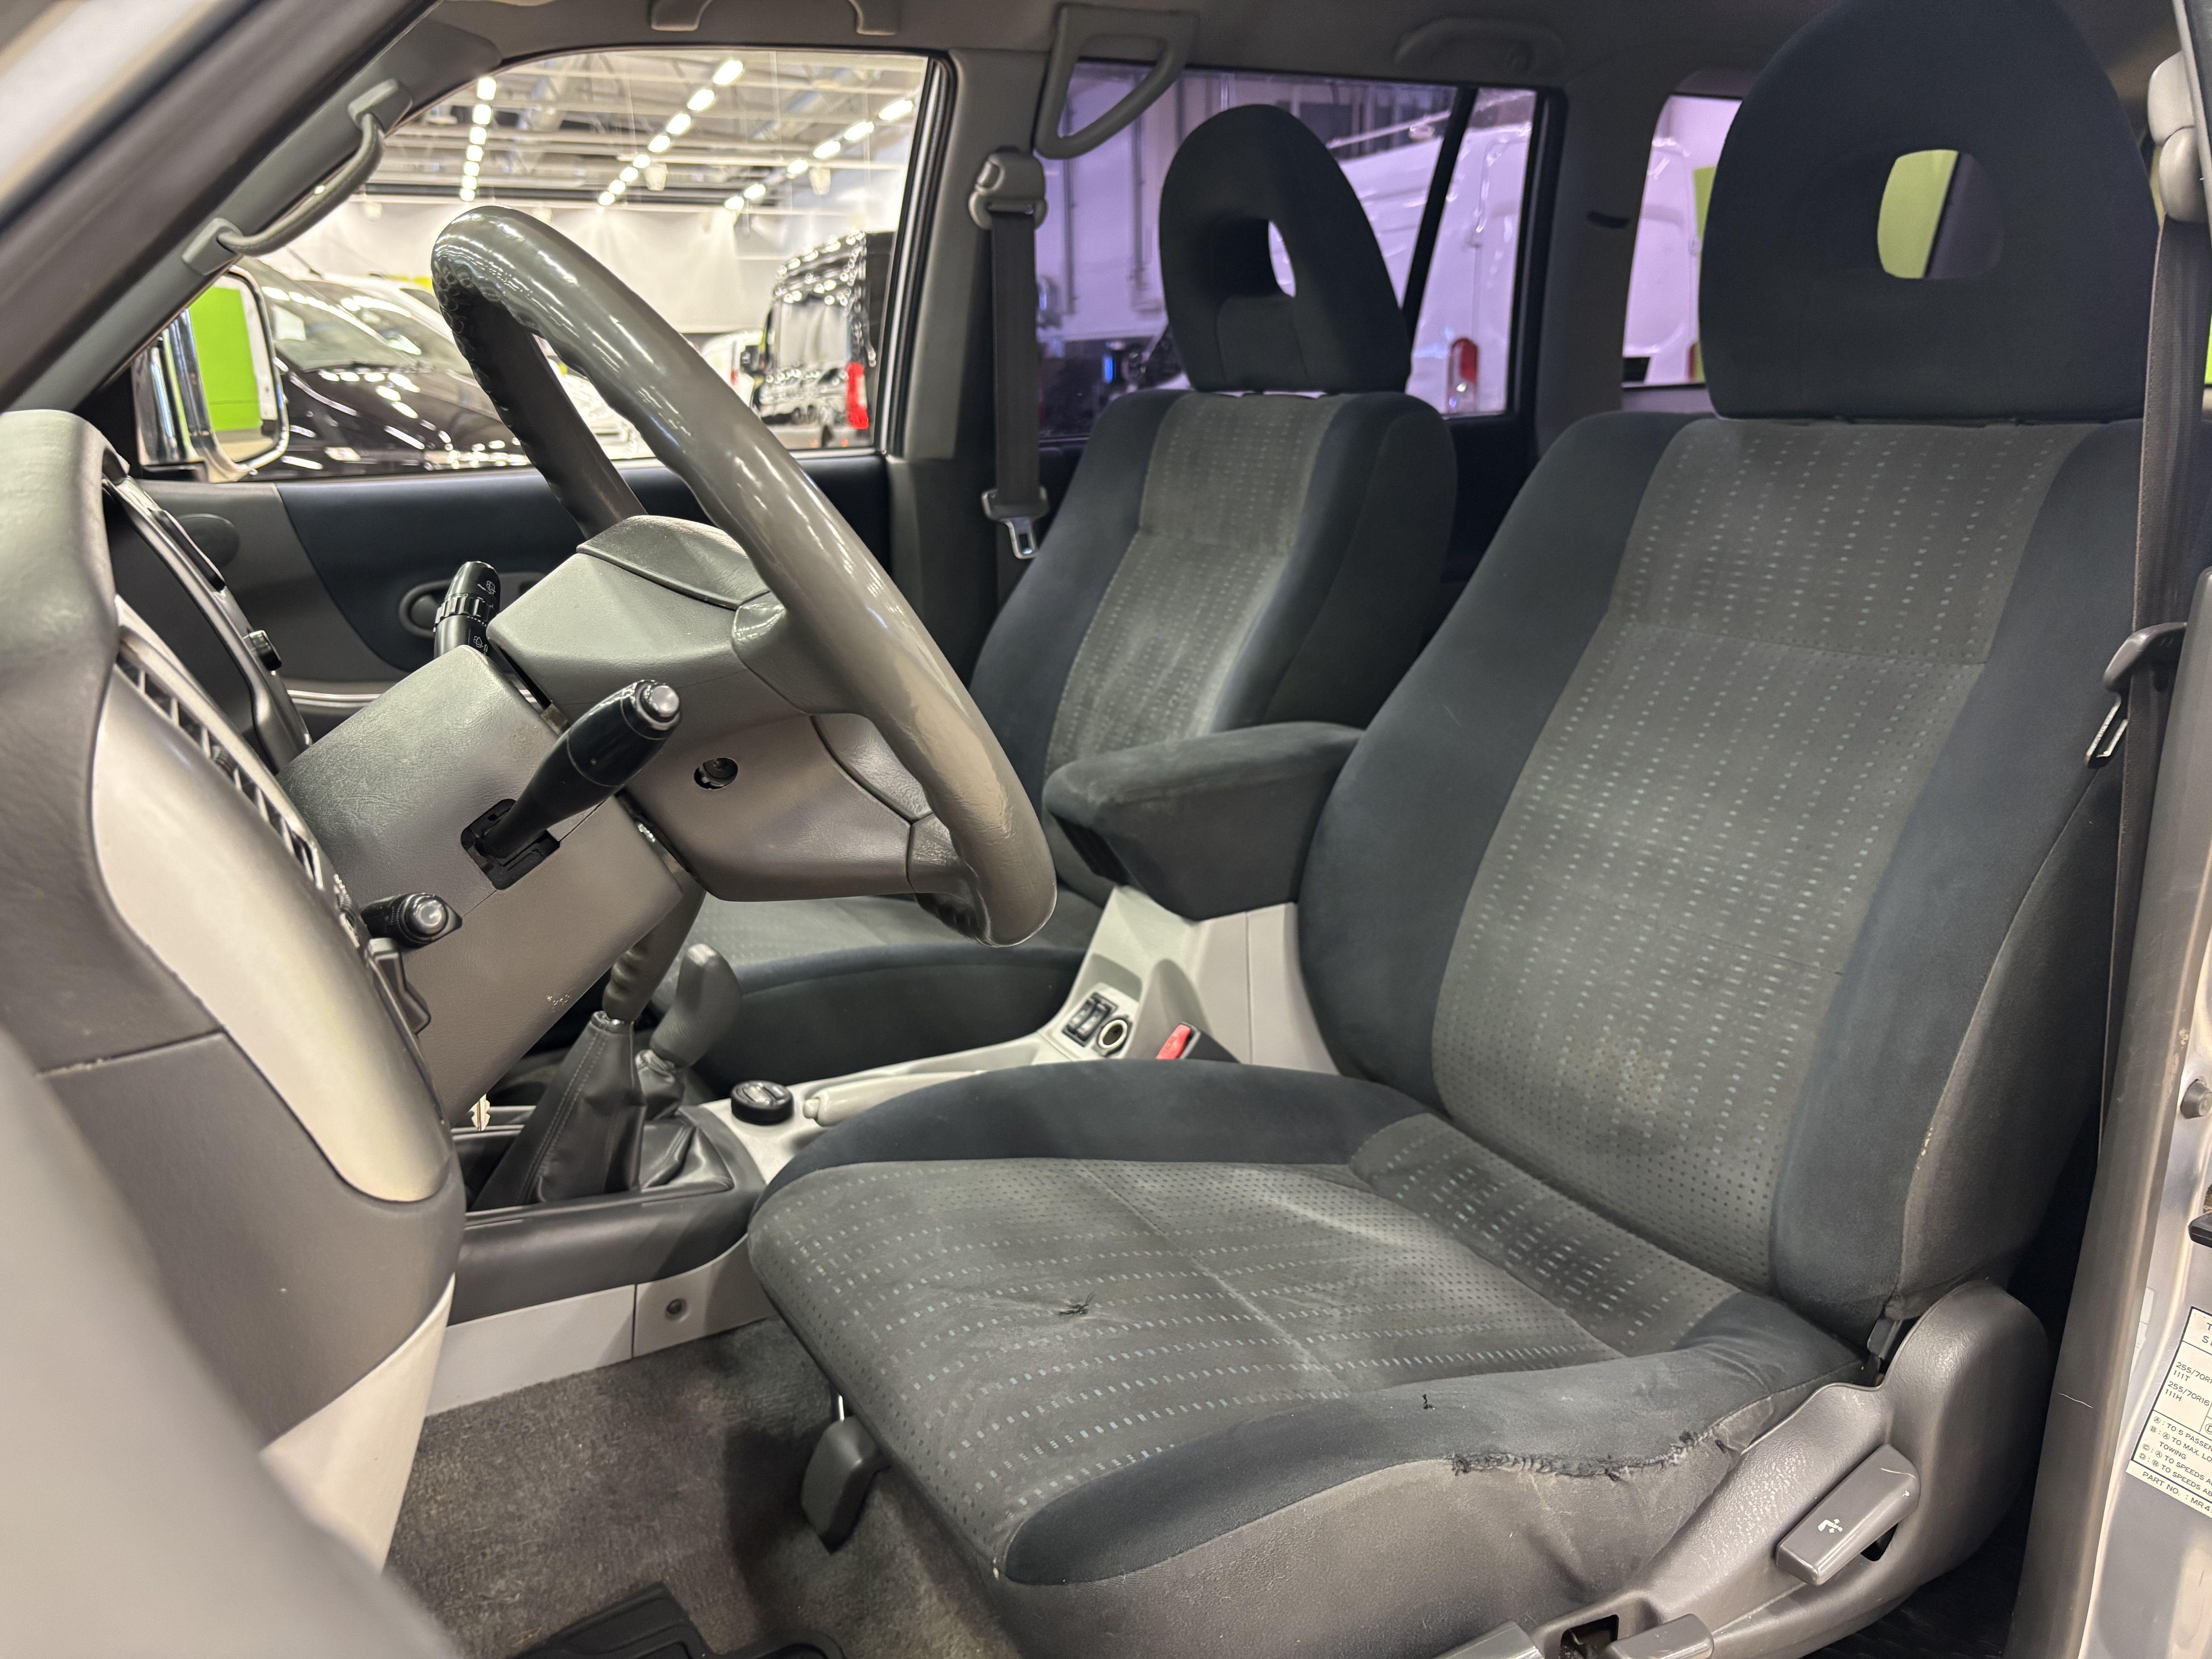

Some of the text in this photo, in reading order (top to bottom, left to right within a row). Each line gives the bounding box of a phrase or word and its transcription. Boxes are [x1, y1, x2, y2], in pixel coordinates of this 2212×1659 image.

[2174, 1370, 2190, 1381] 111T
[2165, 1389, 2182, 1401] 111H
[2167, 1381, 2210, 1406] 255/70R16
[2167, 1423, 2176, 1431] TO
[2185, 1433, 2212, 1451] PASSEN
[2159, 1441, 2186, 1460] TOWING
[2172, 1437, 2181, 1445] TO
[2202, 1453, 2212, 1463] LO
[2162, 1464, 2171, 1473] TO
[2172, 1472, 2201, 1490] SPEEDS
[2165, 1455, 2174, 1463] TO
[2176, 1462, 2205, 1480] SPEEDS
[2142, 1472, 2165, 1486] PART
[2166, 1484, 2180, 1496] NO.
